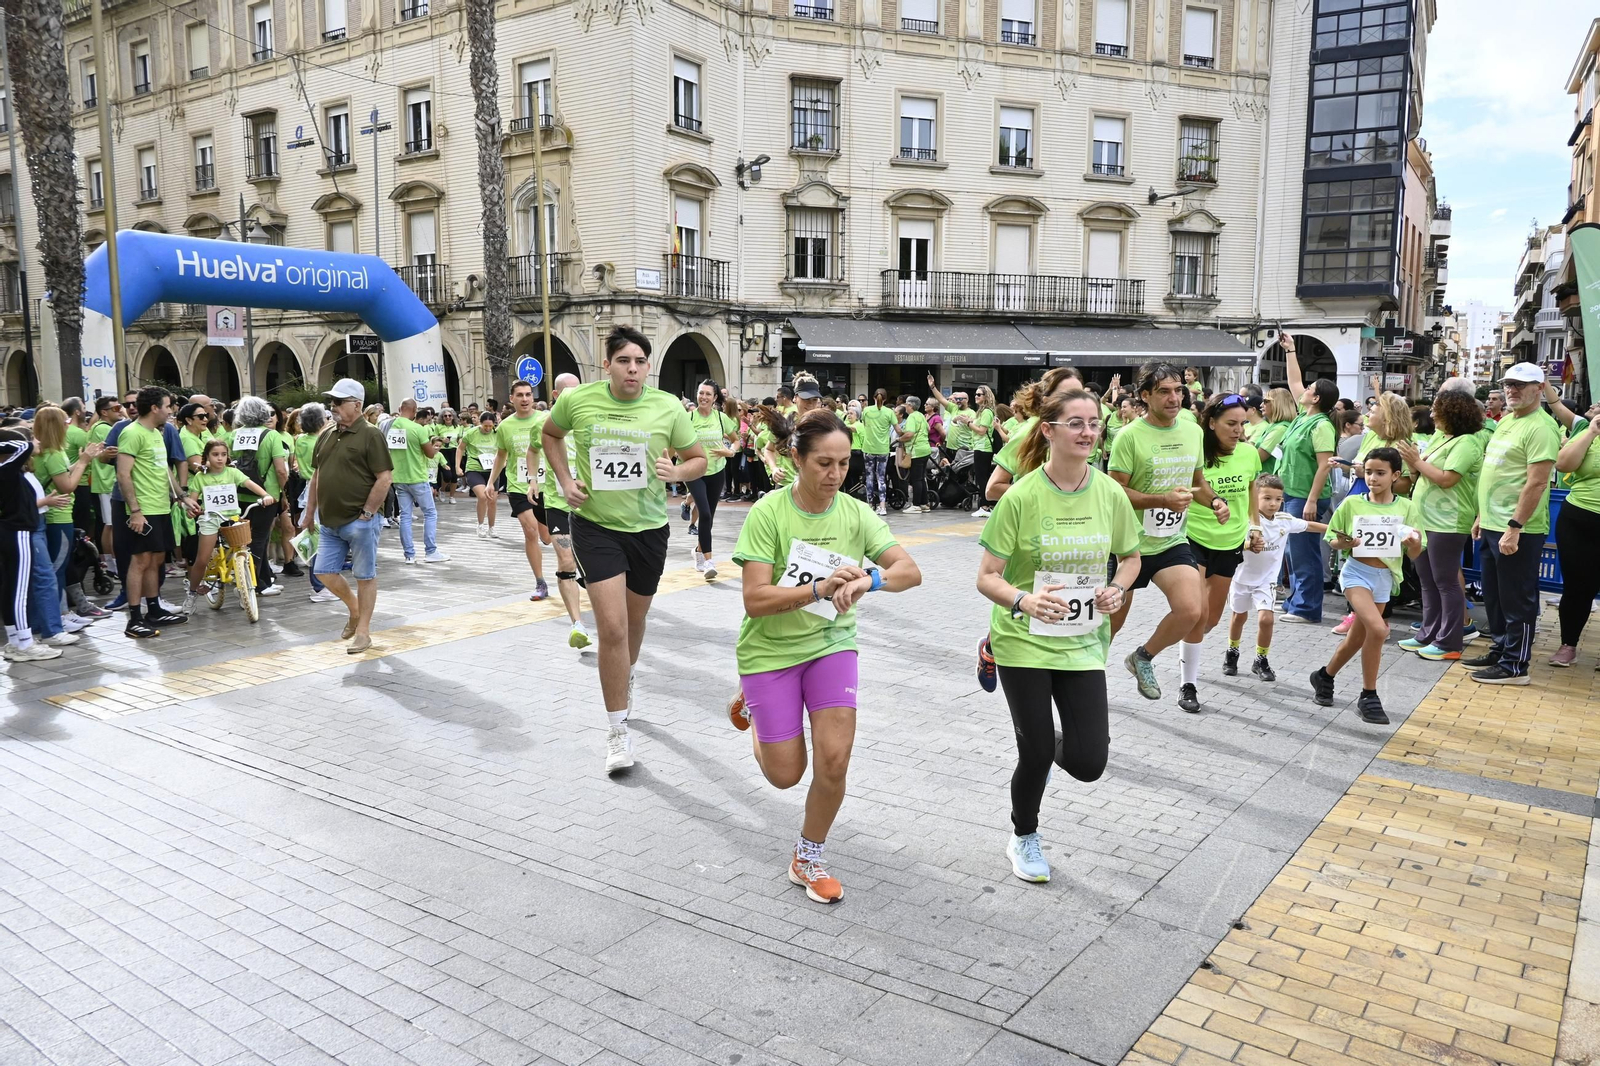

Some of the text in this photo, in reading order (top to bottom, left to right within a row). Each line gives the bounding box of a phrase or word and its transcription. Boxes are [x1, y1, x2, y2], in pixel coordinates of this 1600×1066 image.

[176, 249, 369, 293] Huelva original
[82, 355, 115, 369] uelv
[894, 354, 925, 362] RESTAURANTE
[593, 423, 653, 439] En marcha
[1217, 475, 1243, 485] aecc
[1041, 532, 1110, 546] En marcha
[1041, 548, 1095, 562] contra
